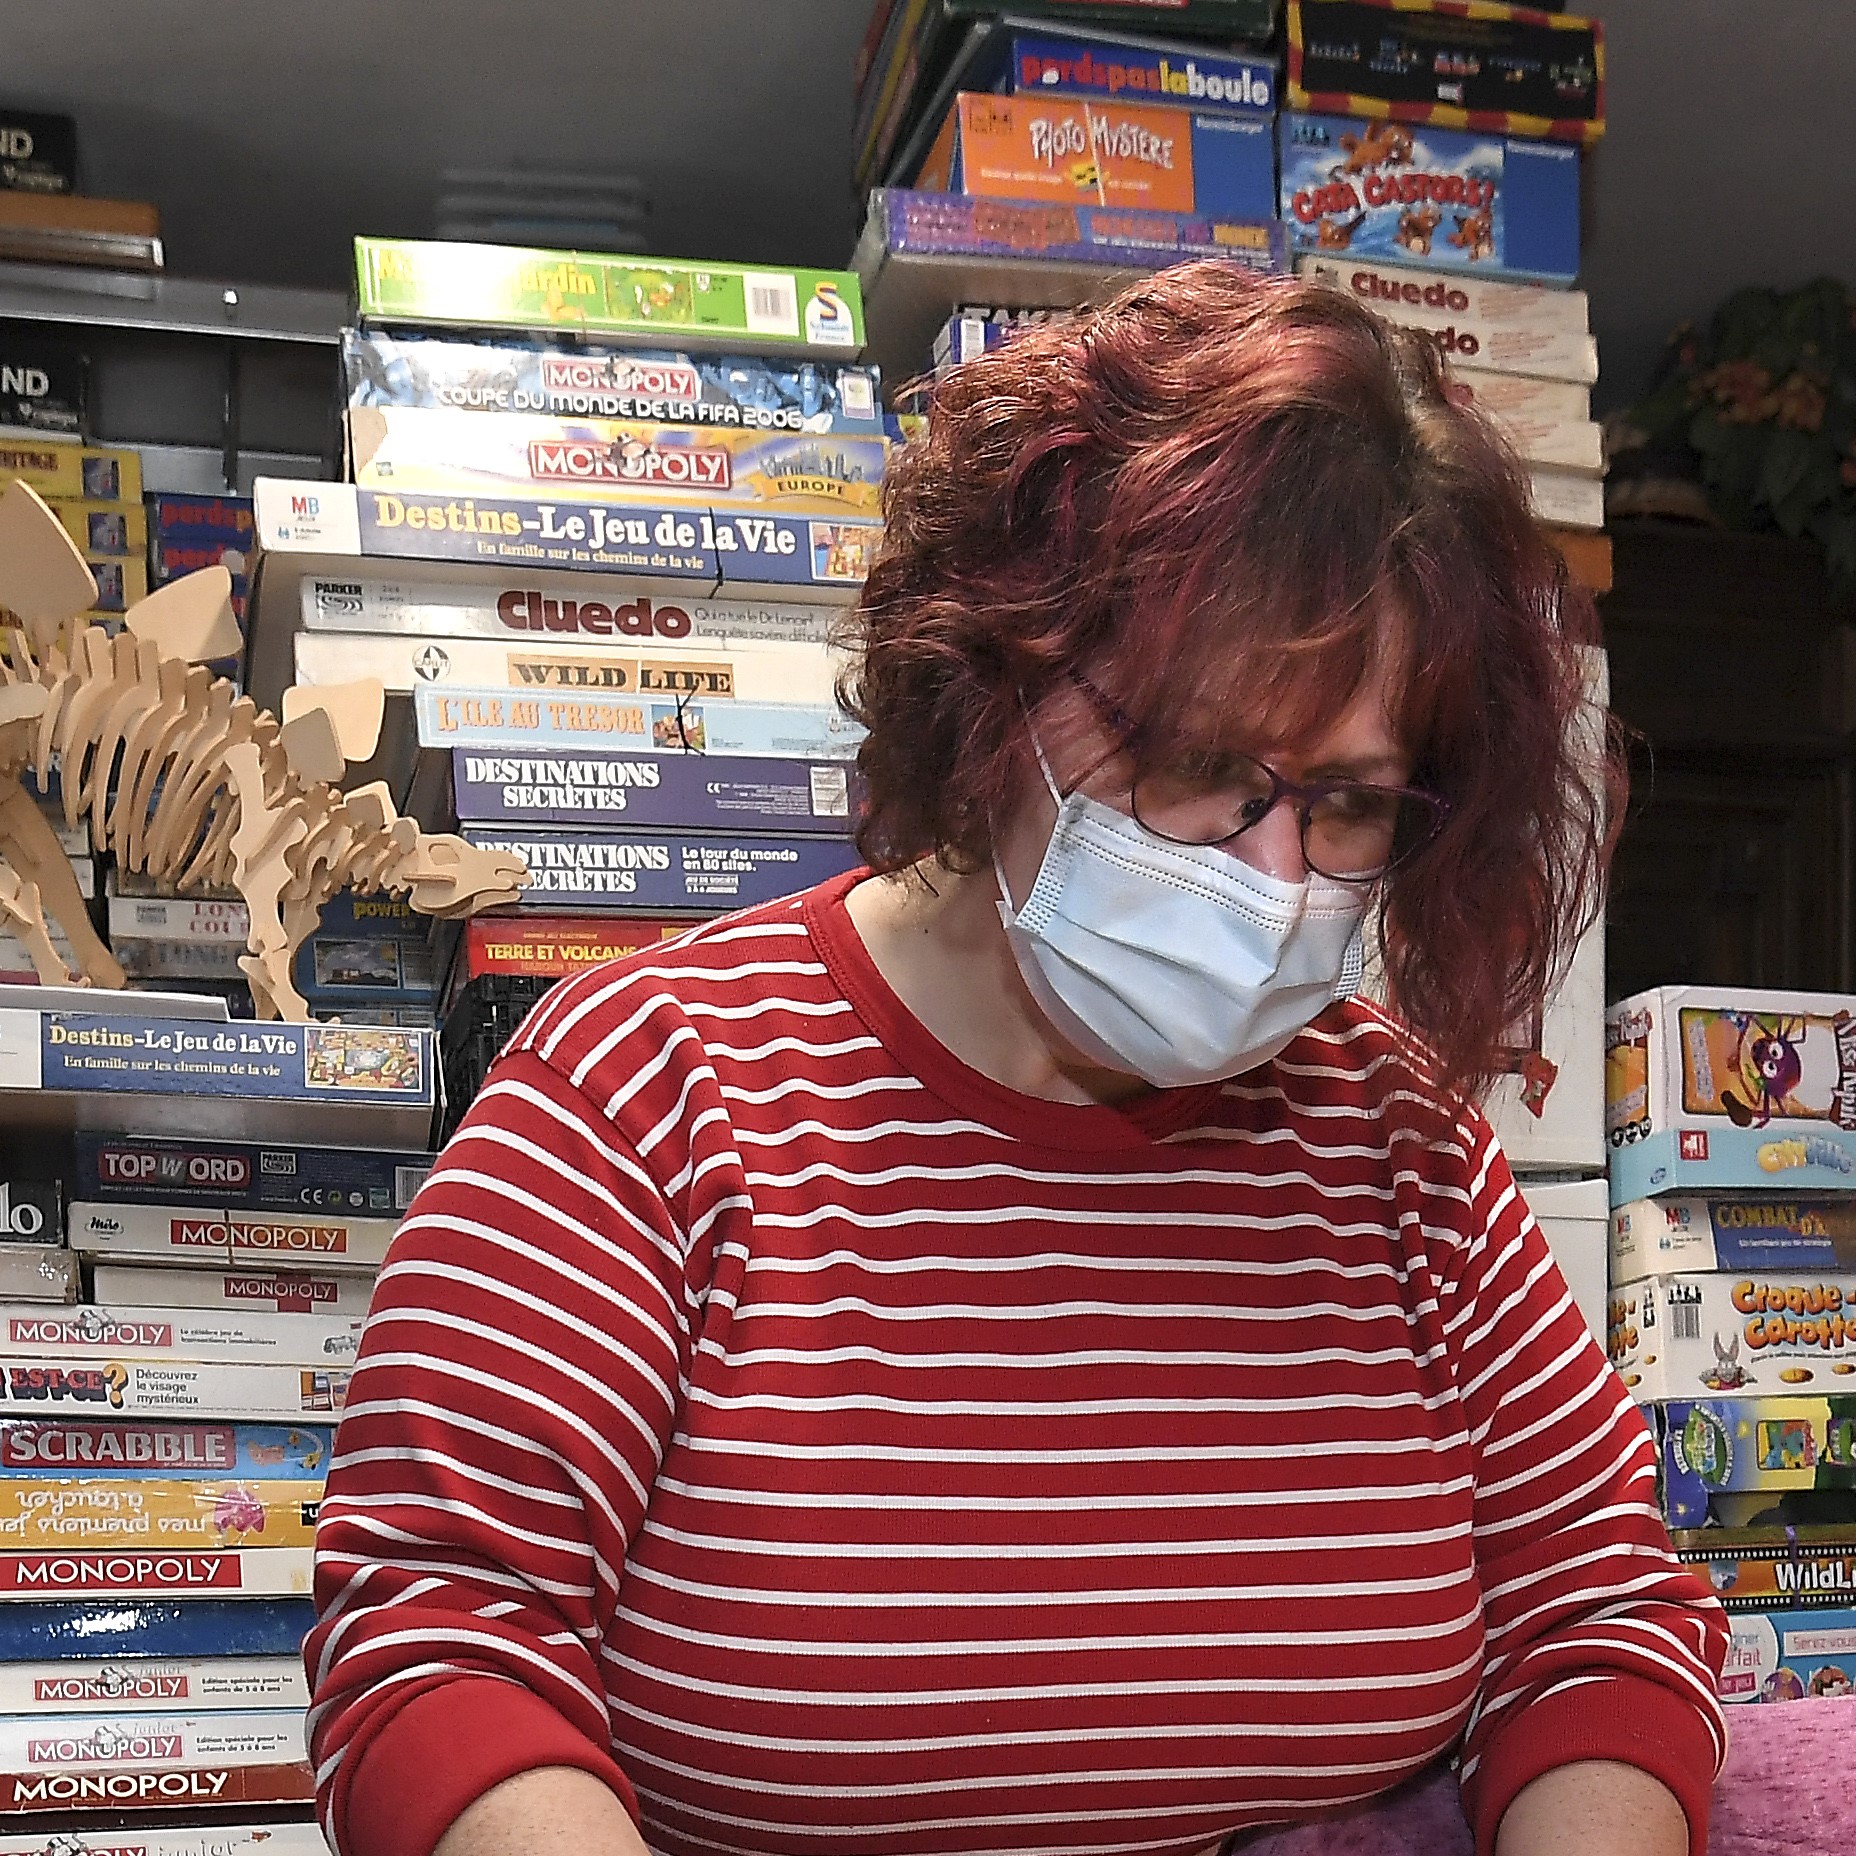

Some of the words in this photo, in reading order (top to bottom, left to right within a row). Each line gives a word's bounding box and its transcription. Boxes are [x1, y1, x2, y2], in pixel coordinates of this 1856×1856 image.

[1350, 269, 1470, 313] Cluedo
[546, 364, 696, 397] MONOPOLY
[440, 385, 508, 409] COUPE
[514, 388, 545, 410] DU
[636, 396, 666, 417] DE
[671, 400, 695, 419] LA
[698, 402, 740, 423] FIFA
[743, 407, 803, 430] 2006
[535, 442, 725, 486] MONOPOLY
[291, 495, 320, 515] MB
[590, 520, 647, 552] Jeu
[660, 520, 694, 549] de
[738, 521, 796, 555] Vie
[499, 541, 546, 558] famille
[592, 547, 647, 566] chemins
[314, 582, 362, 596] PARKER
[497, 590, 692, 640] Cluedo
[513, 659, 626, 688] WILD
[641, 667, 732, 695] LIFE
[437, 697, 504, 732] L'ILE
[508, 702, 540, 730] AU
[546, 702, 646, 737] TRESOR
[464, 757, 661, 789] DESTINATIONS
[682, 847, 698, 860] Le
[700, 847, 732, 861] tour
[755, 849, 799, 862] monde
[485, 945, 537, 960] TERRE
[174, 1029, 210, 1054] Jeu
[217, 1031, 236, 1051] de
[241, 1032, 259, 1052] la
[259, 1034, 297, 1055] Vie
[85, 1056, 128, 1071] famille
[174, 1060, 222, 1074] chemins
[1665, 1206, 1691, 1225] MB
[1717, 1205, 1798, 1228] COMBAT
[181, 1220, 339, 1242] MONOPOLY
[230, 1280, 332, 1300] MONOPOLY
[16, 1320, 164, 1346] MONOPOLY
[135, 1368, 199, 1382] Découvrez
[136, 1392, 200, 1406] mystérieux
[149, 1381, 188, 1397] visage
[9, 1429, 228, 1463] SCRABBLE
[34, 1512, 150, 1538] premiers
[16, 1558, 223, 1585] MONOPOLY
[39, 1676, 183, 1700] MONOPOLY
[34, 1735, 178, 1762] MONOPOLY
[12, 1771, 229, 1803] MONOPOLY
